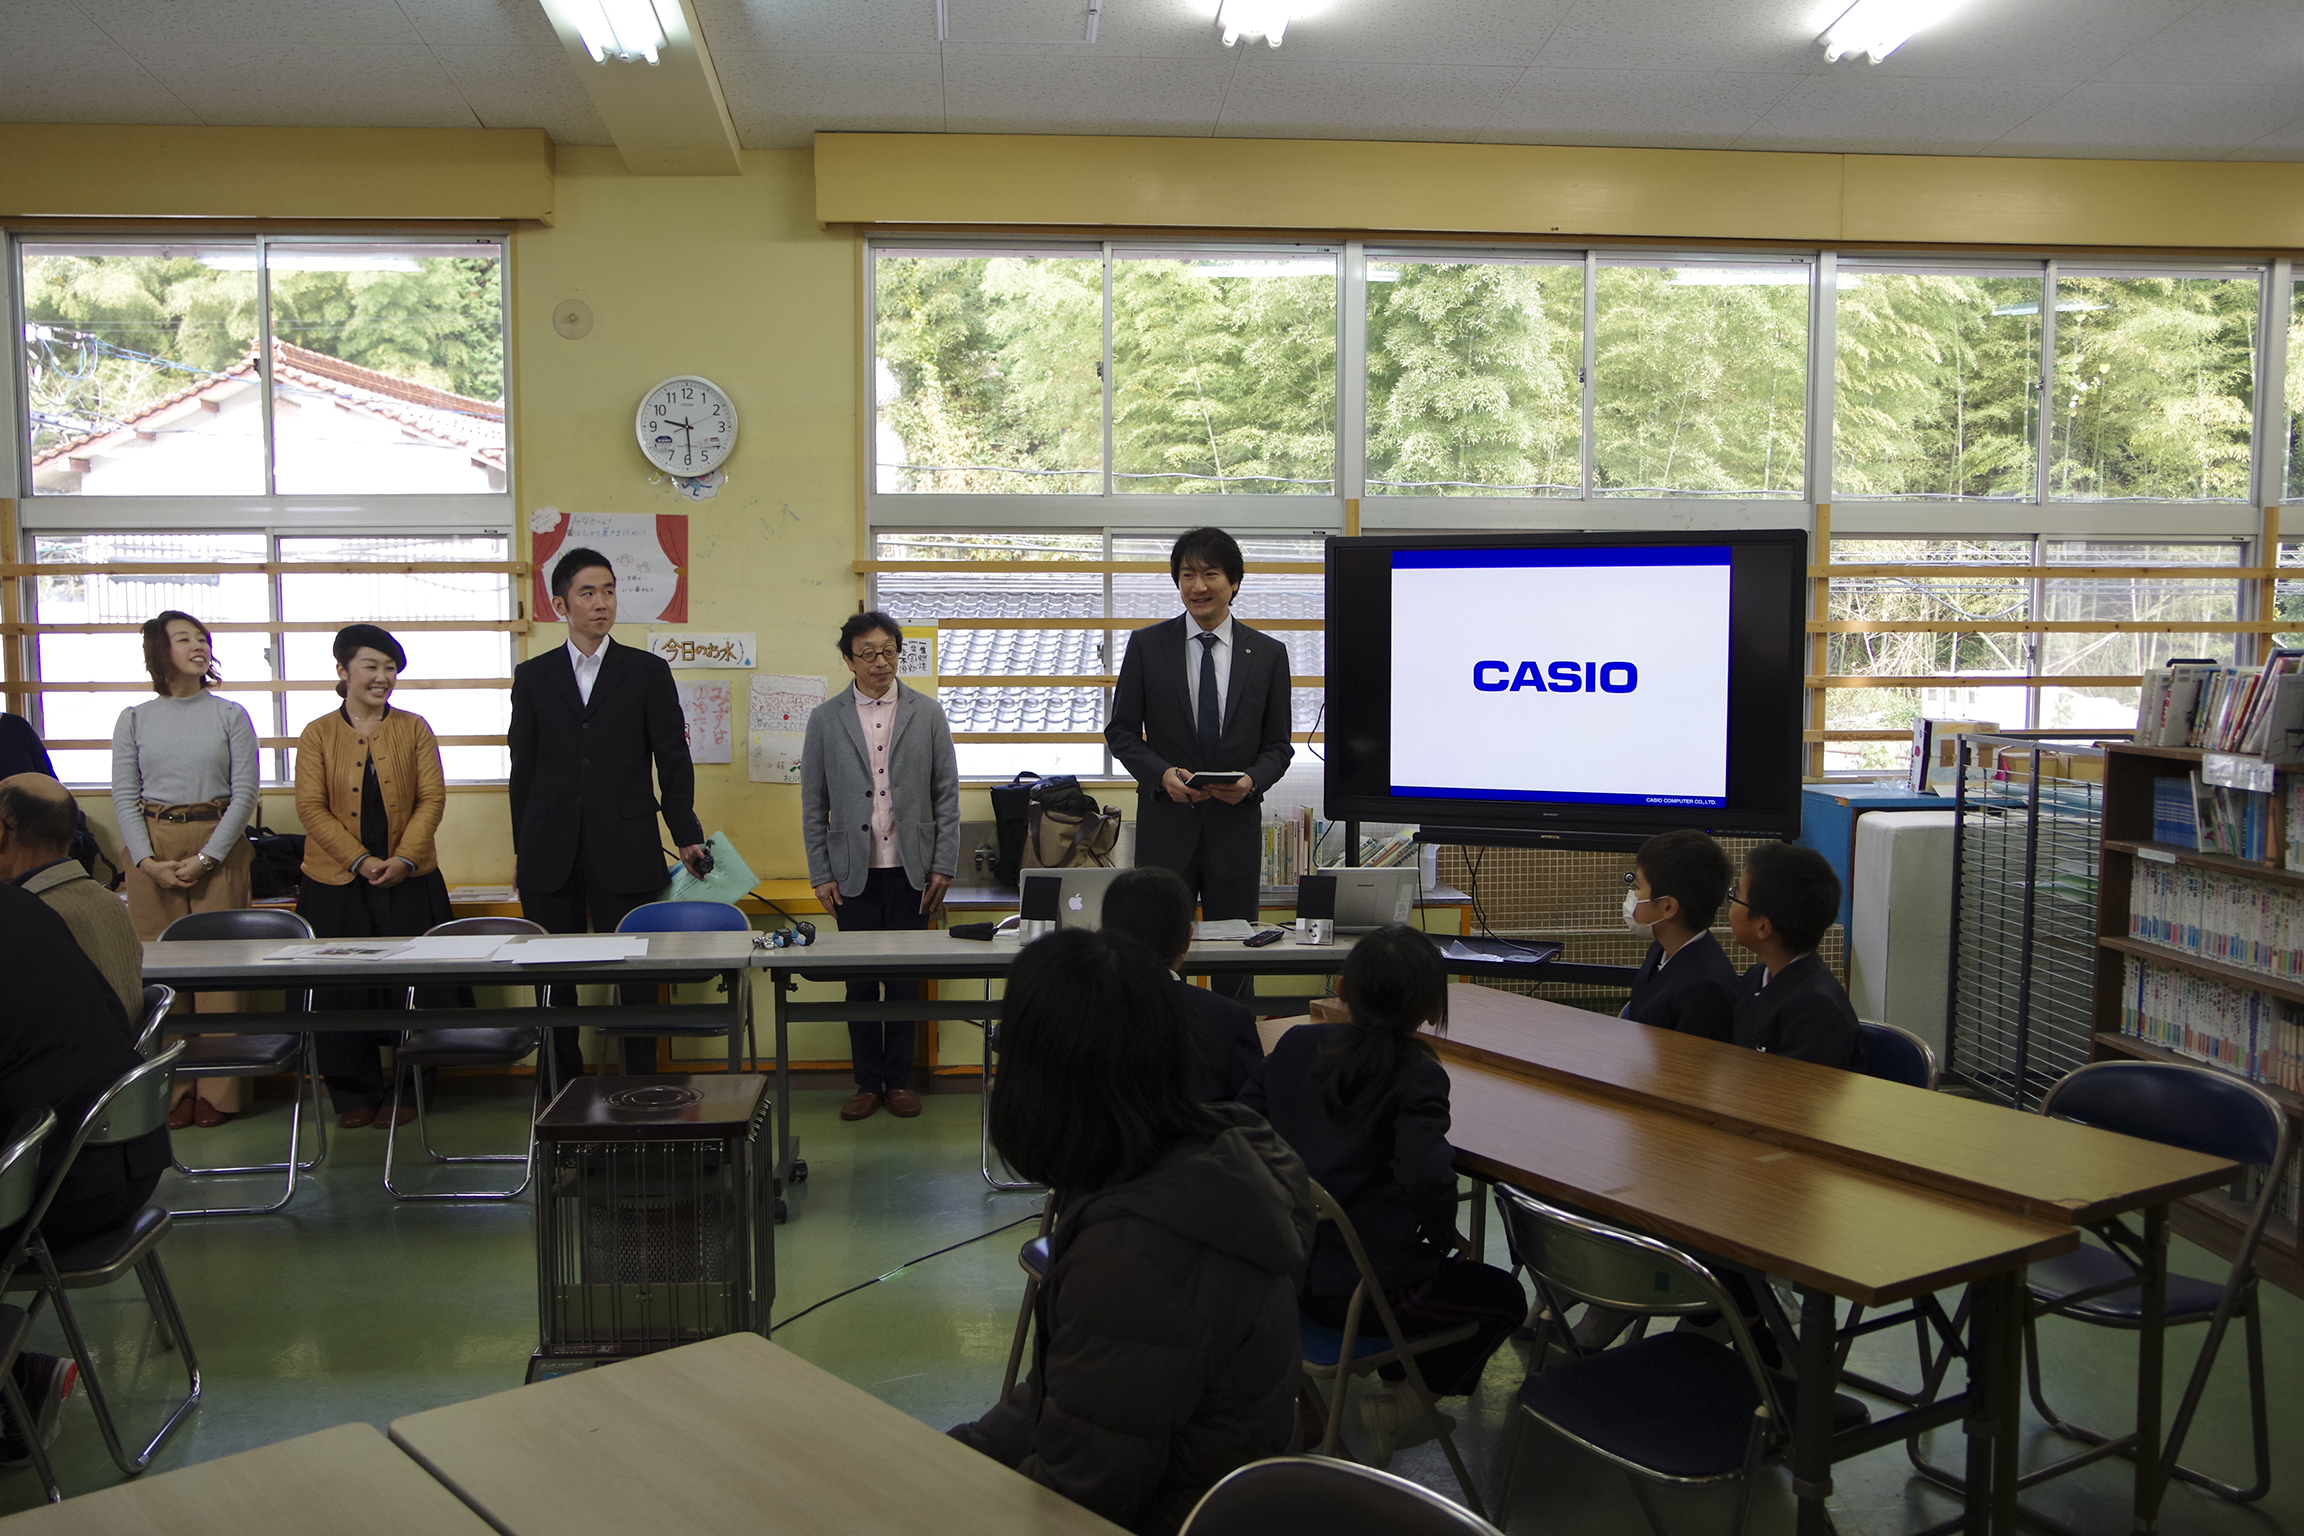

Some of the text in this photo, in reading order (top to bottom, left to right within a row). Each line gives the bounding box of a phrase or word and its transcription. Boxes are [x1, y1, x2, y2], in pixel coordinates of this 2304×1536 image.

[666, 392, 677, 404] 11
[681, 388, 694, 400] 12
[701, 392, 706, 404] 1
[654, 404, 667, 416] 10
[712, 404, 720, 416] 2
[649, 420, 657, 432] 9
[718, 421, 726, 433] 3
[668, 450, 675, 461] 7
[684, 453, 692, 466] 6
[701, 450, 709, 462] 5
[661, 638, 737, 662] 今日のお水
[1473, 660, 1639, 694] CASIO
